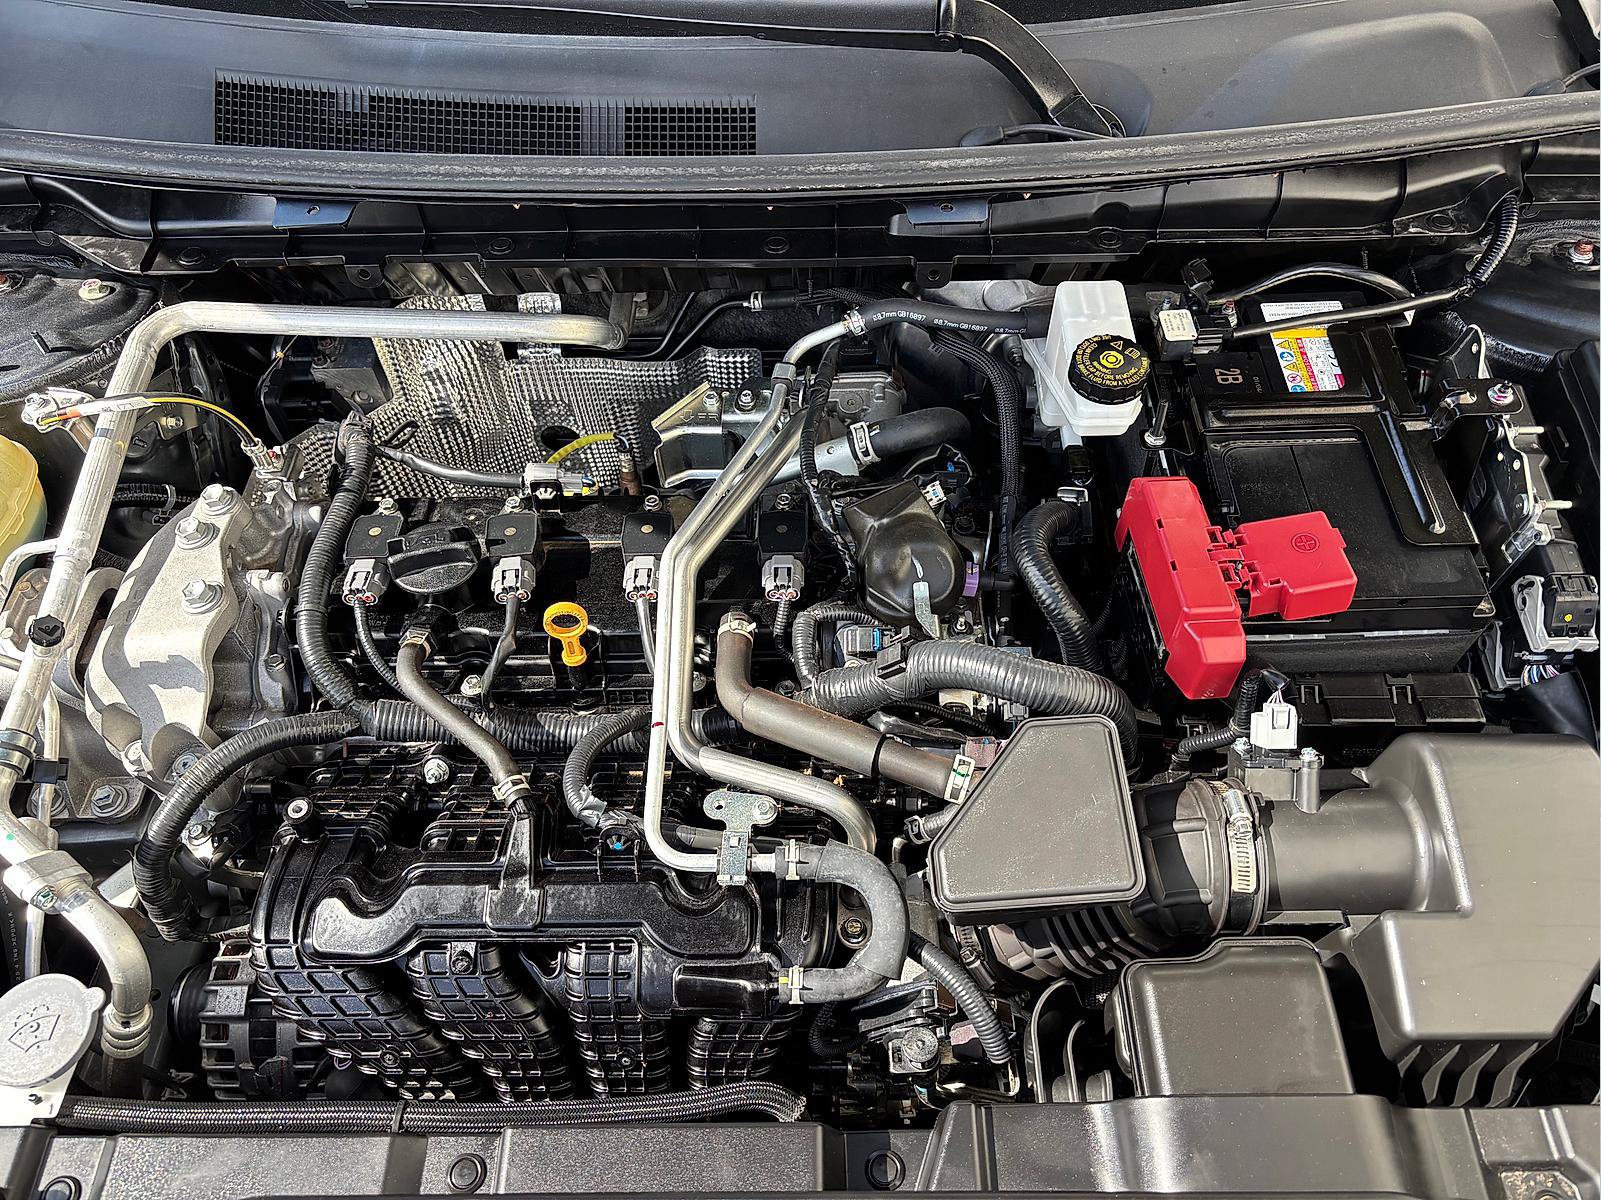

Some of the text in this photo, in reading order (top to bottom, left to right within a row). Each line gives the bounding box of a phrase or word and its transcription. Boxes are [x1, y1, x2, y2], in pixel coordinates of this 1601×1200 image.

[897, 310, 927, 322] GB16897
[959, 322, 989, 332] GB16897
[1086, 364, 1097, 373] CAP
[1094, 371, 1114, 380] BEFORE
[1214, 368, 1244, 385] 2B
